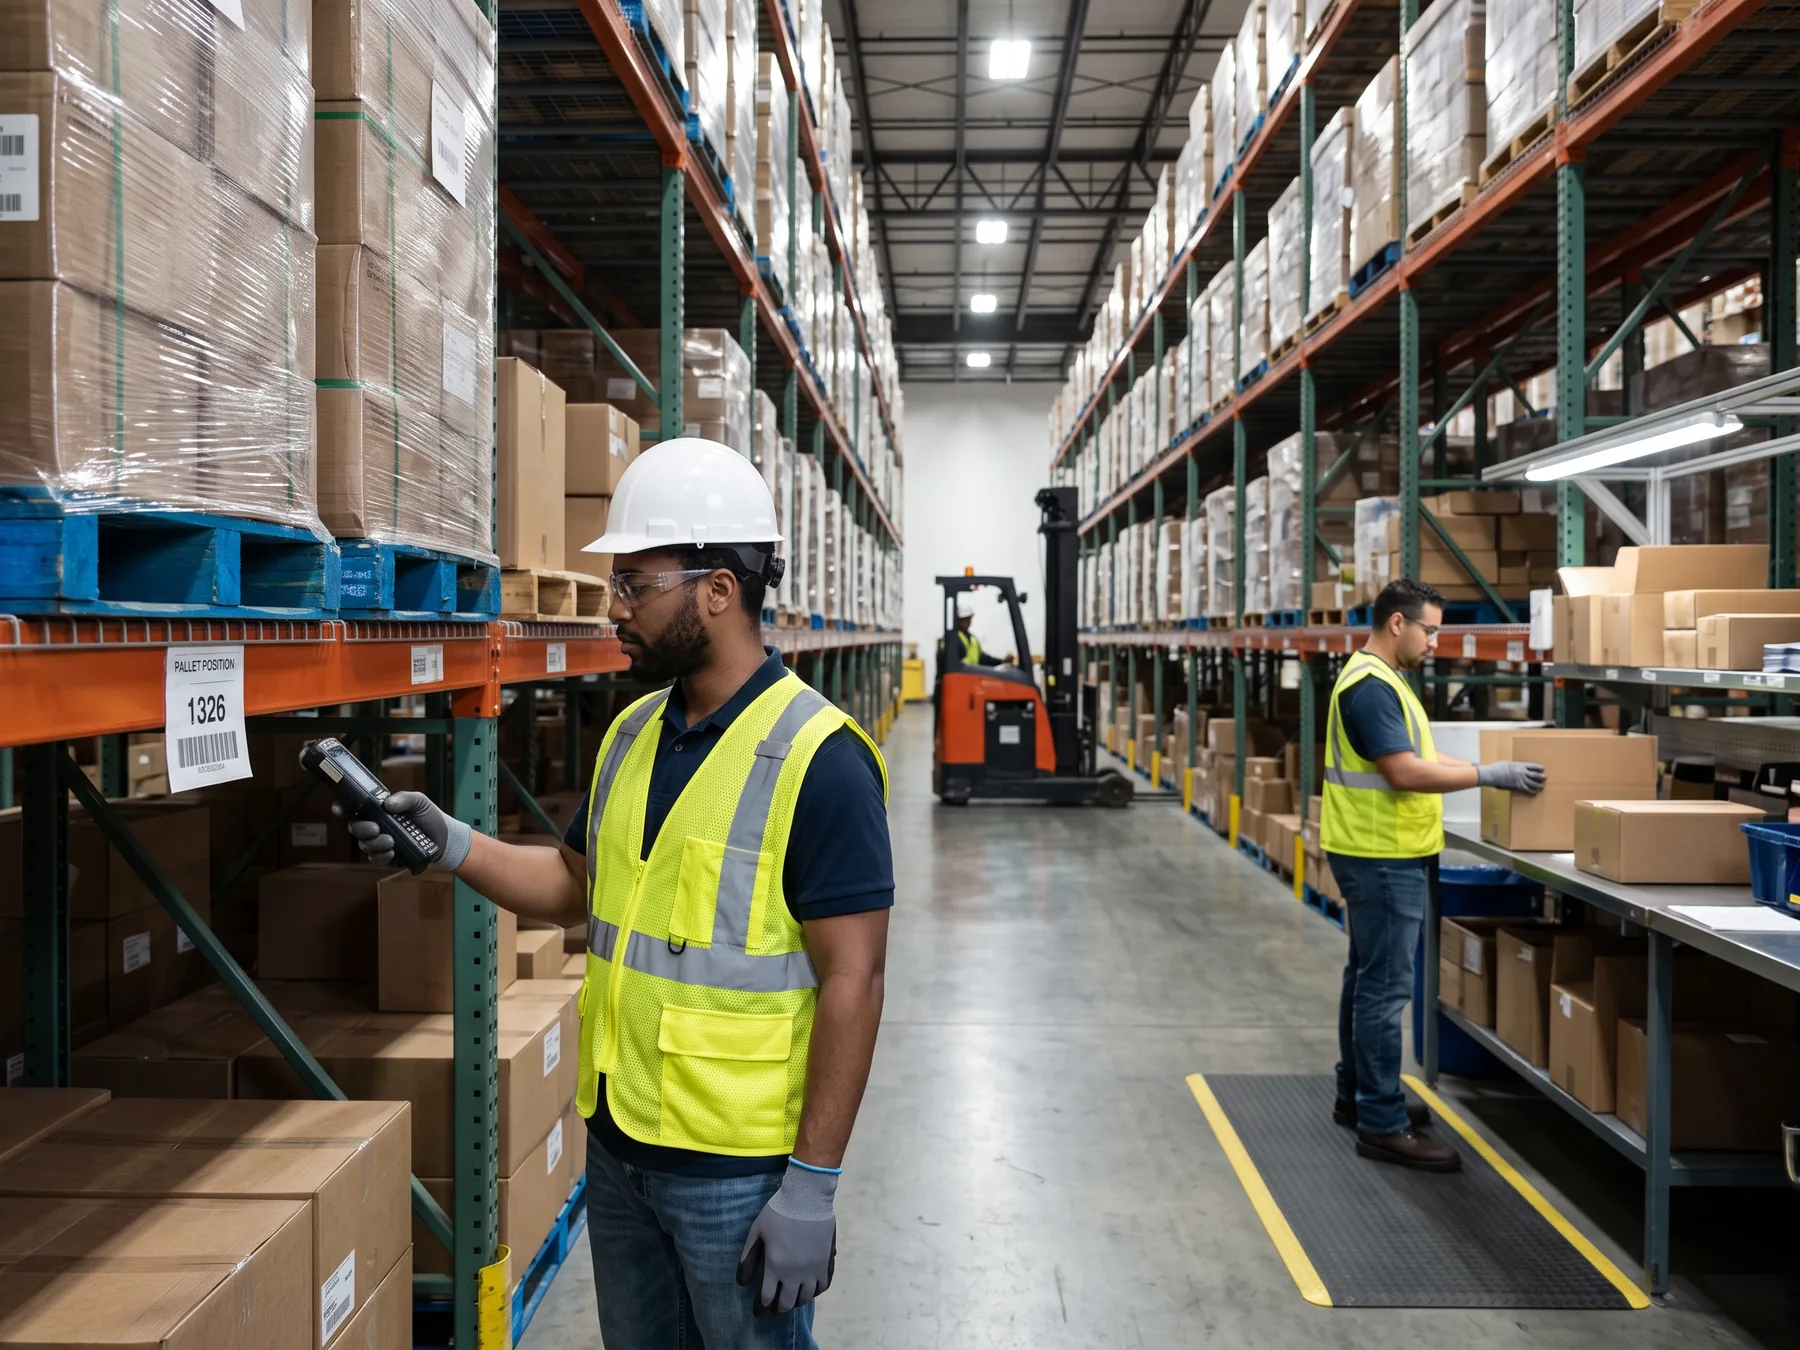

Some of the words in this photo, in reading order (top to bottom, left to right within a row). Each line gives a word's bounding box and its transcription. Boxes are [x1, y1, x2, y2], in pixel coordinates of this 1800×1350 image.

[174, 660, 201, 673] PALLET
[202, 658, 235, 671] POSITION
[188, 694, 226, 725] 1326
